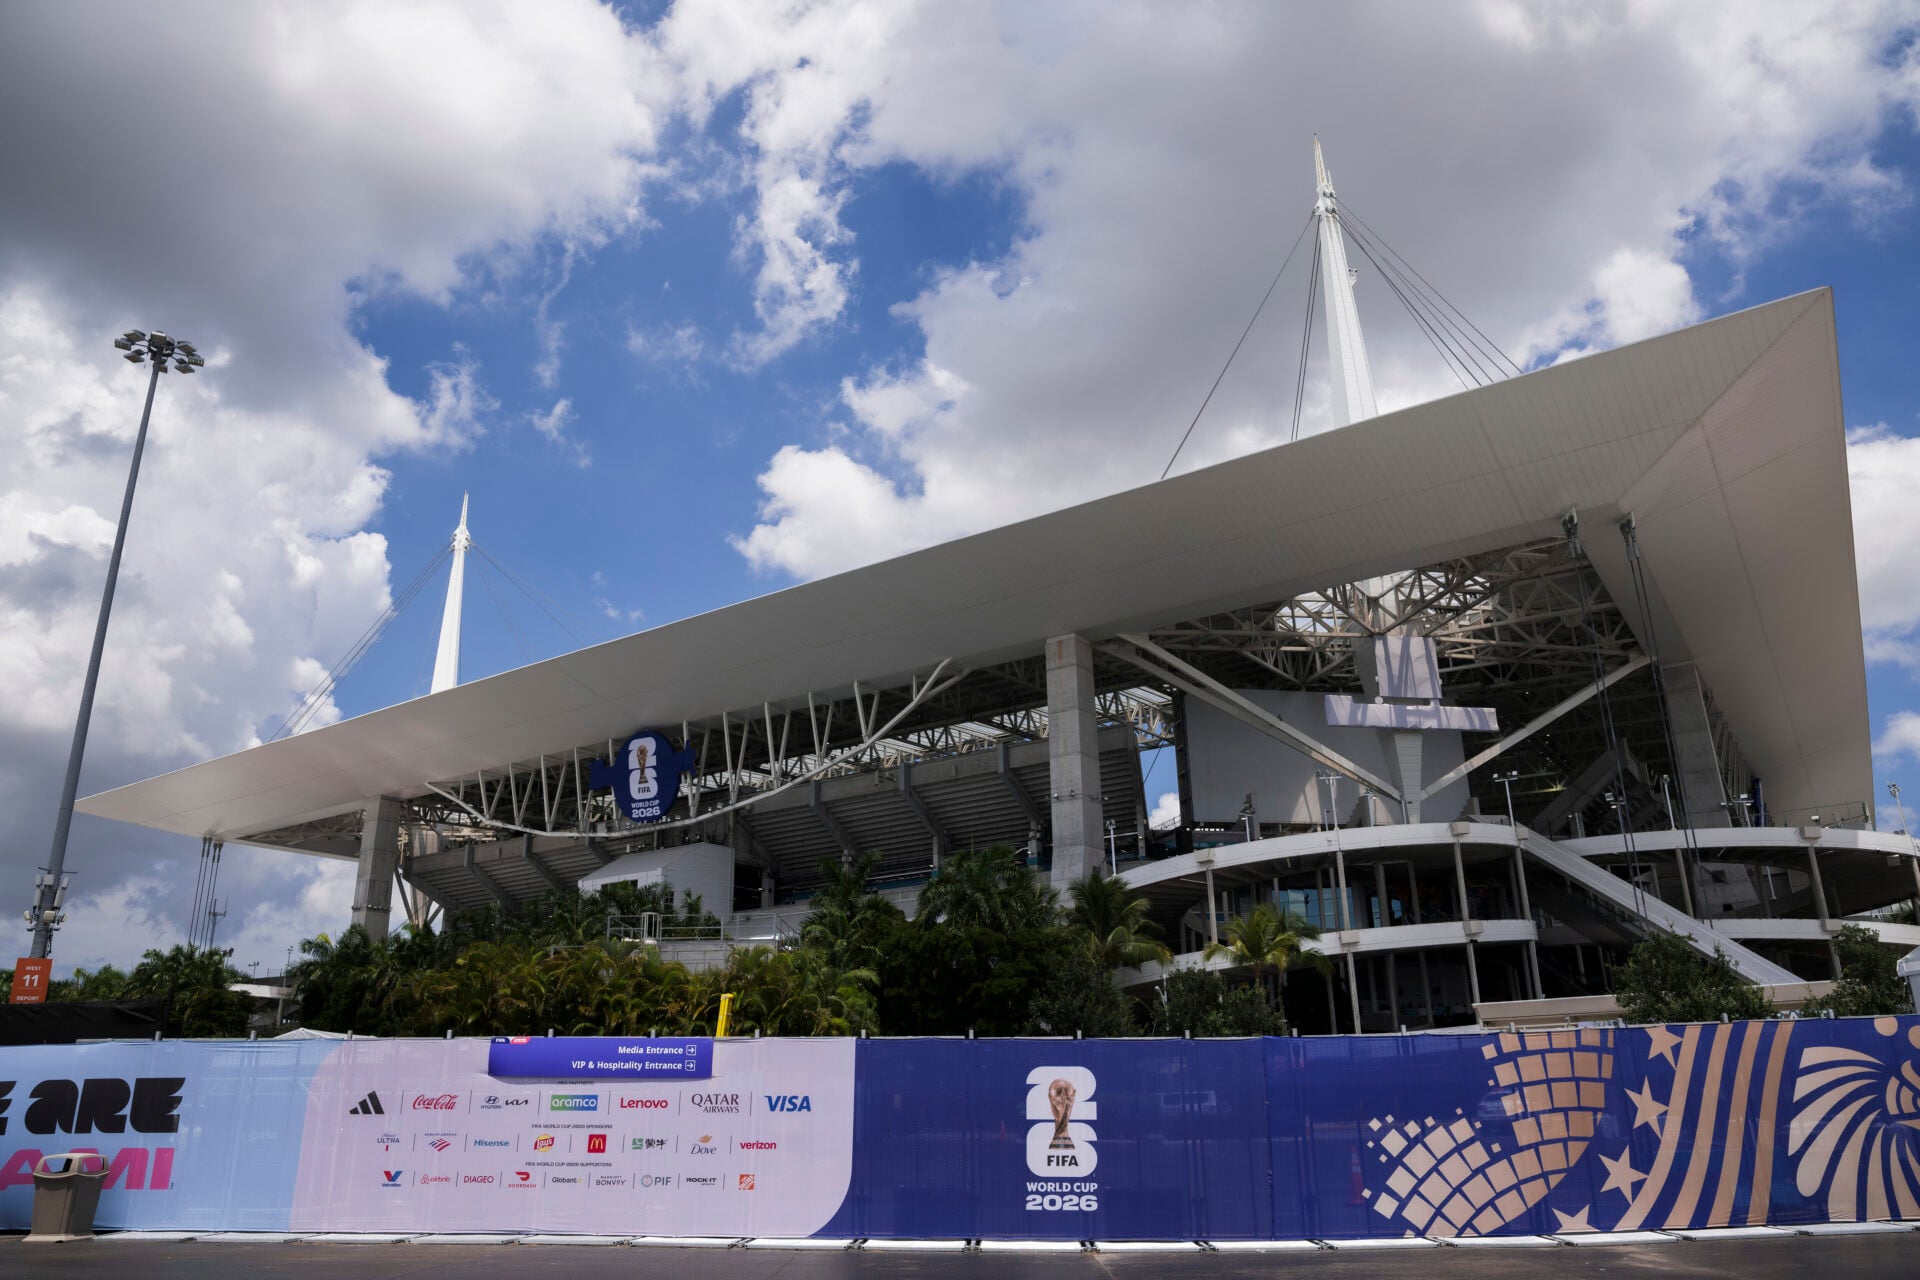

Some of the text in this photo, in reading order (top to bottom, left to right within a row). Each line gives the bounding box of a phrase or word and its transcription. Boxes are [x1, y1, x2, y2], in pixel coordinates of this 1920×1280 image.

[637, 786, 651, 794] FIFA
[631, 801, 649, 809] WORLD
[632, 806, 661, 818] 2026
[22, 974, 39, 987] 11
[618, 1046, 684, 1054] Media Entrance
[572, 1061, 683, 1071] VIP & Hospitality Entrance
[552, 1099, 597, 1107] aramco
[620, 1098, 668, 1109] Lenovo
[691, 1094, 739, 1107] QATAR
[763, 1095, 812, 1112] VISA
[703, 1106, 740, 1114] AIRWAYS
[474, 1139, 510, 1147] Hisense
[740, 1140, 777, 1150] verizon
[690, 1144, 717, 1155] Dove
[1047, 1155, 1079, 1167] FIFA
[463, 1175, 494, 1183] DIAGEO
[654, 1176, 672, 1186] PIF
[1026, 1182, 1098, 1192] WORLD CUP
[1025, 1194, 1098, 1211] 2026
